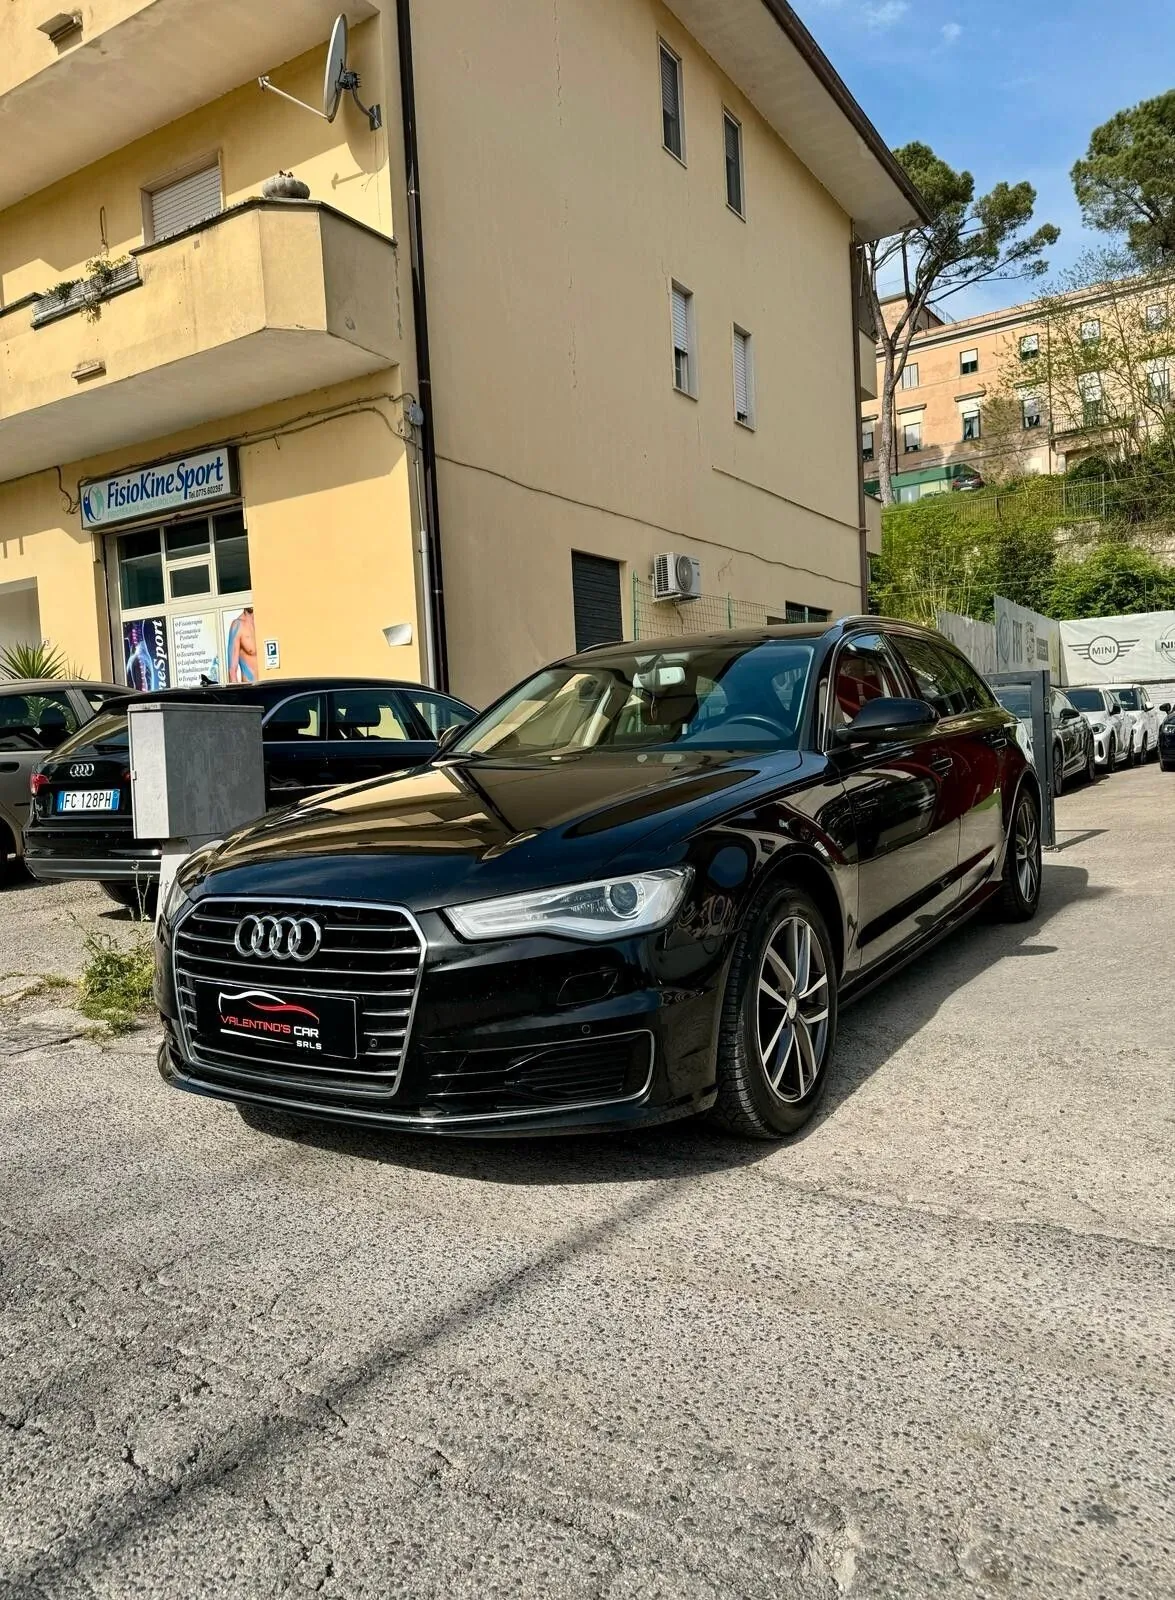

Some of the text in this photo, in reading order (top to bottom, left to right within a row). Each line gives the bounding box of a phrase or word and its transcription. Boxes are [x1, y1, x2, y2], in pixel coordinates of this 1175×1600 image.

[268, 644, 275, 655] P
[1092, 645, 1116, 655] MINI
[64, 792, 112, 808] FC 128PH
[220, 1015, 319, 1039] VALENTINO'S CAR
[296, 1039, 322, 1050] SRLS
